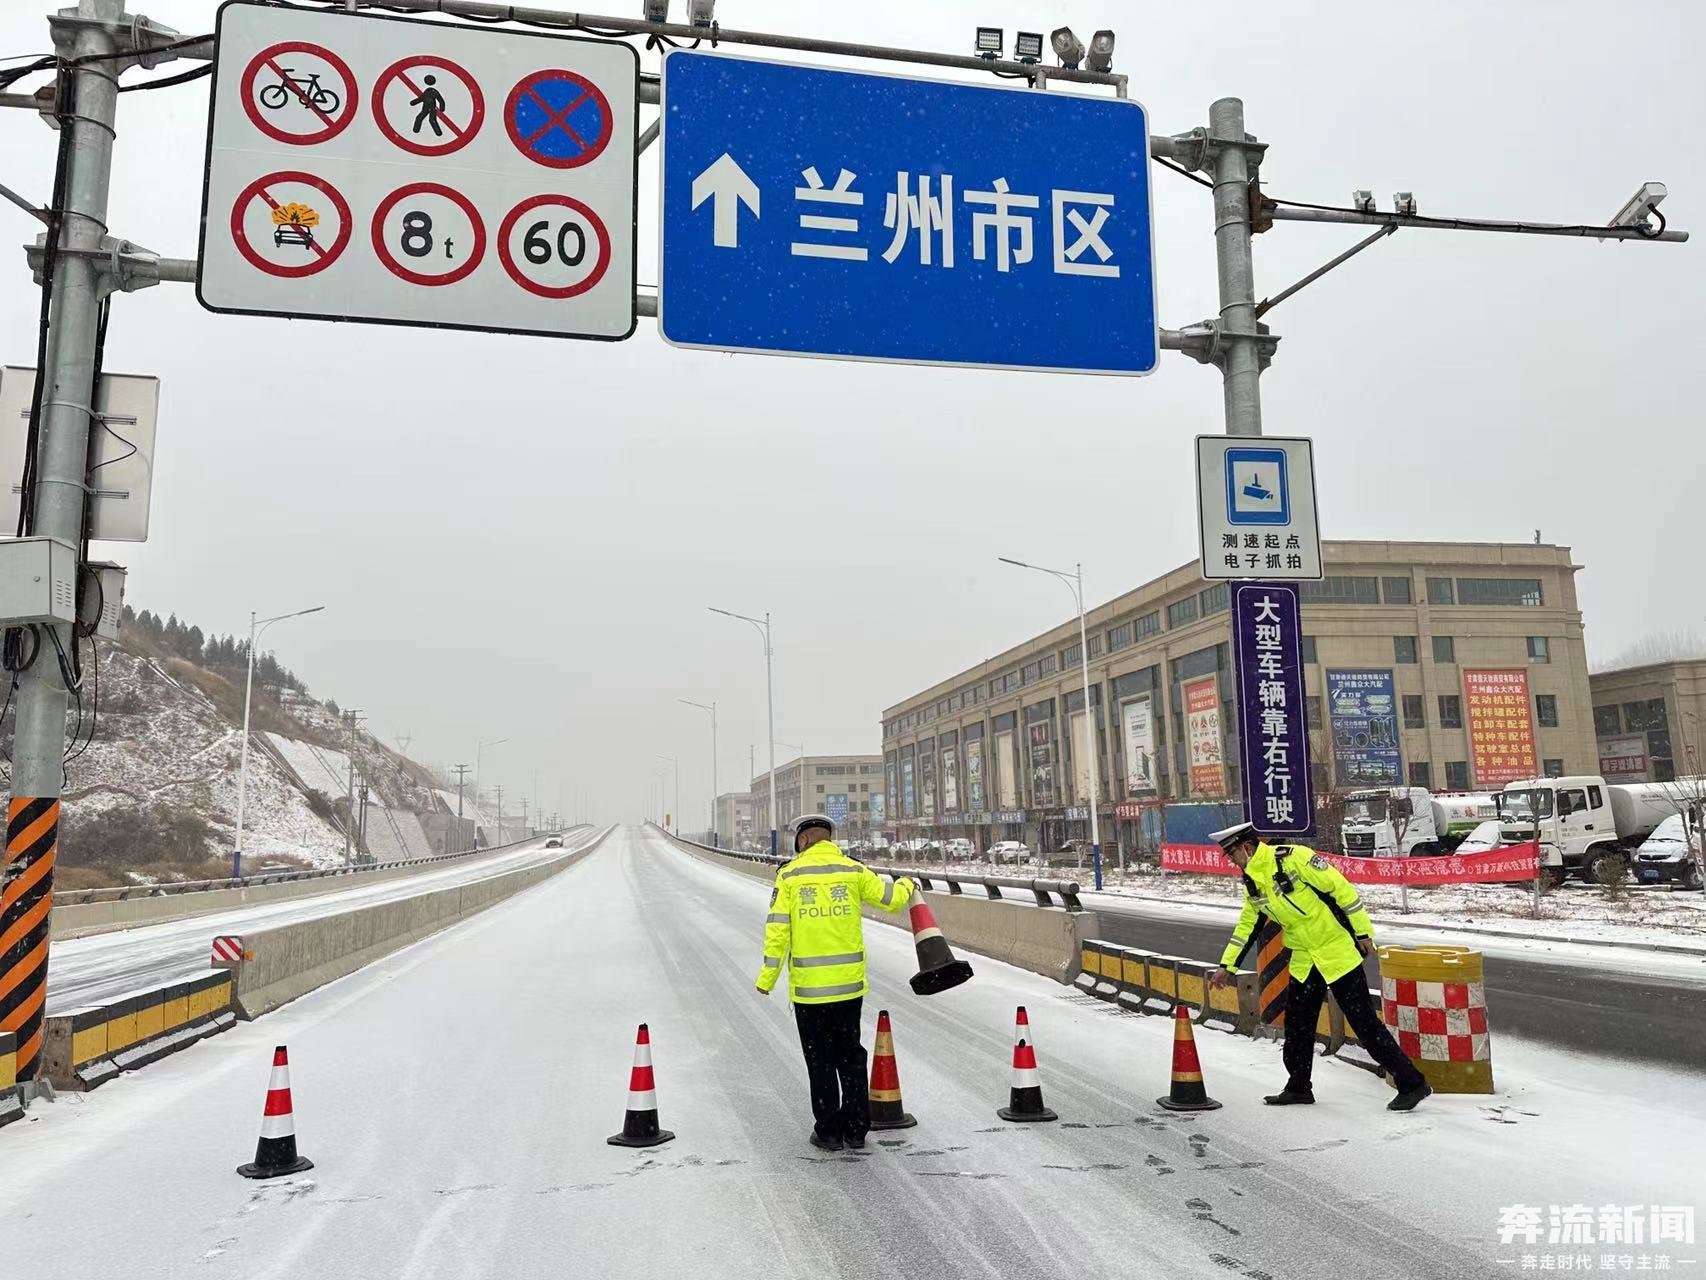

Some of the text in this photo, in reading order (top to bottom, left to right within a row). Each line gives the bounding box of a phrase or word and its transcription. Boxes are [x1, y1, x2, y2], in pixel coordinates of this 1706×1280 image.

[791, 166, 1120, 277] 兰州市区
[401, 210, 454, 258] 8t
[523, 220, 586, 267] 60
[1222, 533, 1300, 549] 测速起点
[1224, 553, 1301, 569] 电子抓拍
[1470, 695, 1526, 705] 发动机配件
[1254, 596, 1294, 824] 大型车辆靠右行驶
[1471, 707, 1528, 717] 搅拌罐配件
[1473, 719, 1529, 729] 自卸车配套
[1473, 731, 1530, 742] 特种车配件
[1475, 743, 1532, 754] 驾驶室总成
[1476, 756, 1534, 766] 各种油品
[799, 885, 849, 905] 警察
[799, 904, 851, 919] POLICE
